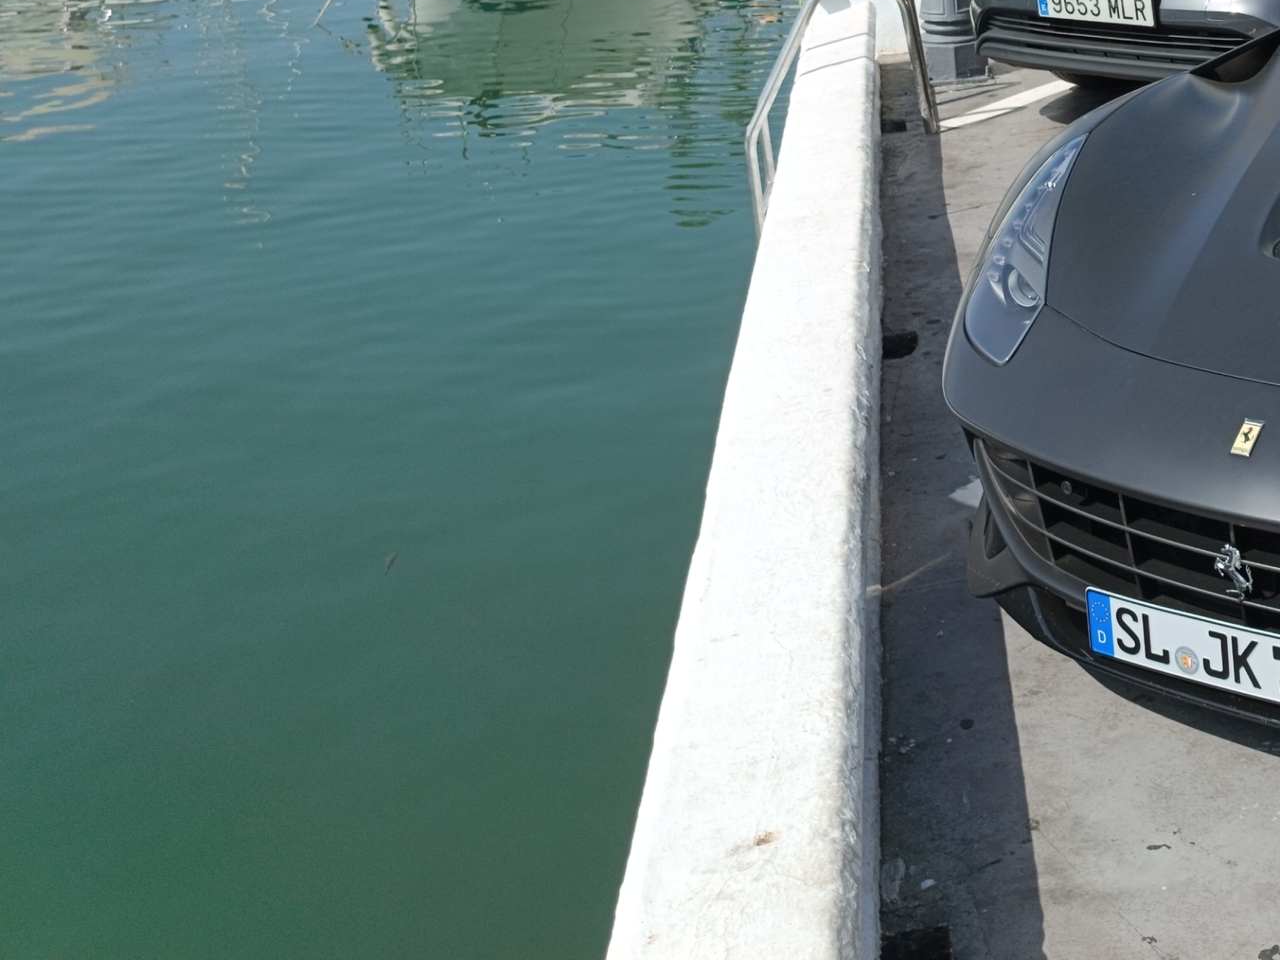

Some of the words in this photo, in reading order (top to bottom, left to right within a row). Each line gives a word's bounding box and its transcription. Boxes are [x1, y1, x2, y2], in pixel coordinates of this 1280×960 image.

[1097, 630, 1106, 643] D
[1116, 607, 1170, 664] SL
[1203, 630, 1262, 689] JK
